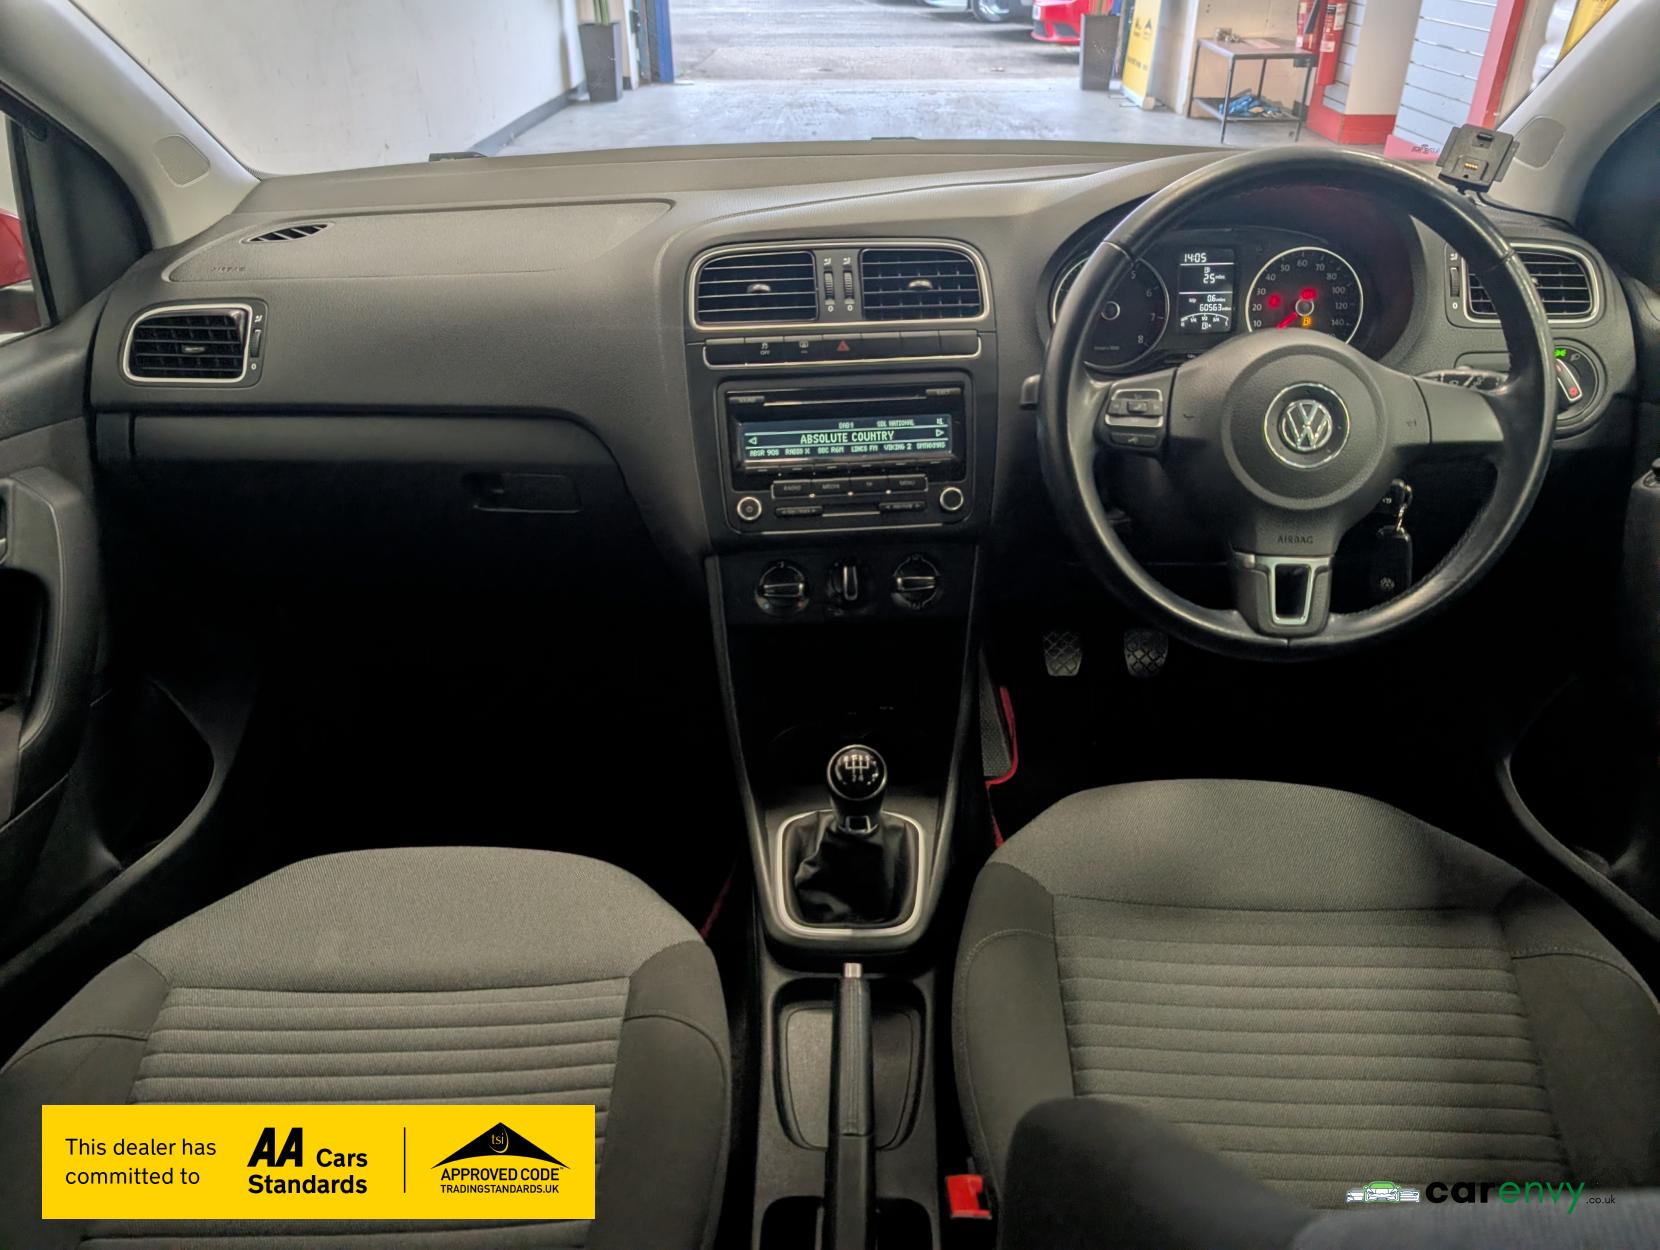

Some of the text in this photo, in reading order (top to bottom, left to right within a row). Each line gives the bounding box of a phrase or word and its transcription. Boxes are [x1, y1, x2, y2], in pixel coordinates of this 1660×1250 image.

[1297, 259, 1308, 267] 60
[1316, 263, 1325, 271] 70
[1280, 264, 1290, 272] 50
[1203, 273, 1215, 284] 25
[1265, 273, 1276, 281] 40
[1332, 286, 1345, 294] 100
[1199, 303, 1222, 312] 60563
[1335, 302, 1348, 310] 120
[800, 430, 895, 444] ABSOLUTE COUNTRY
